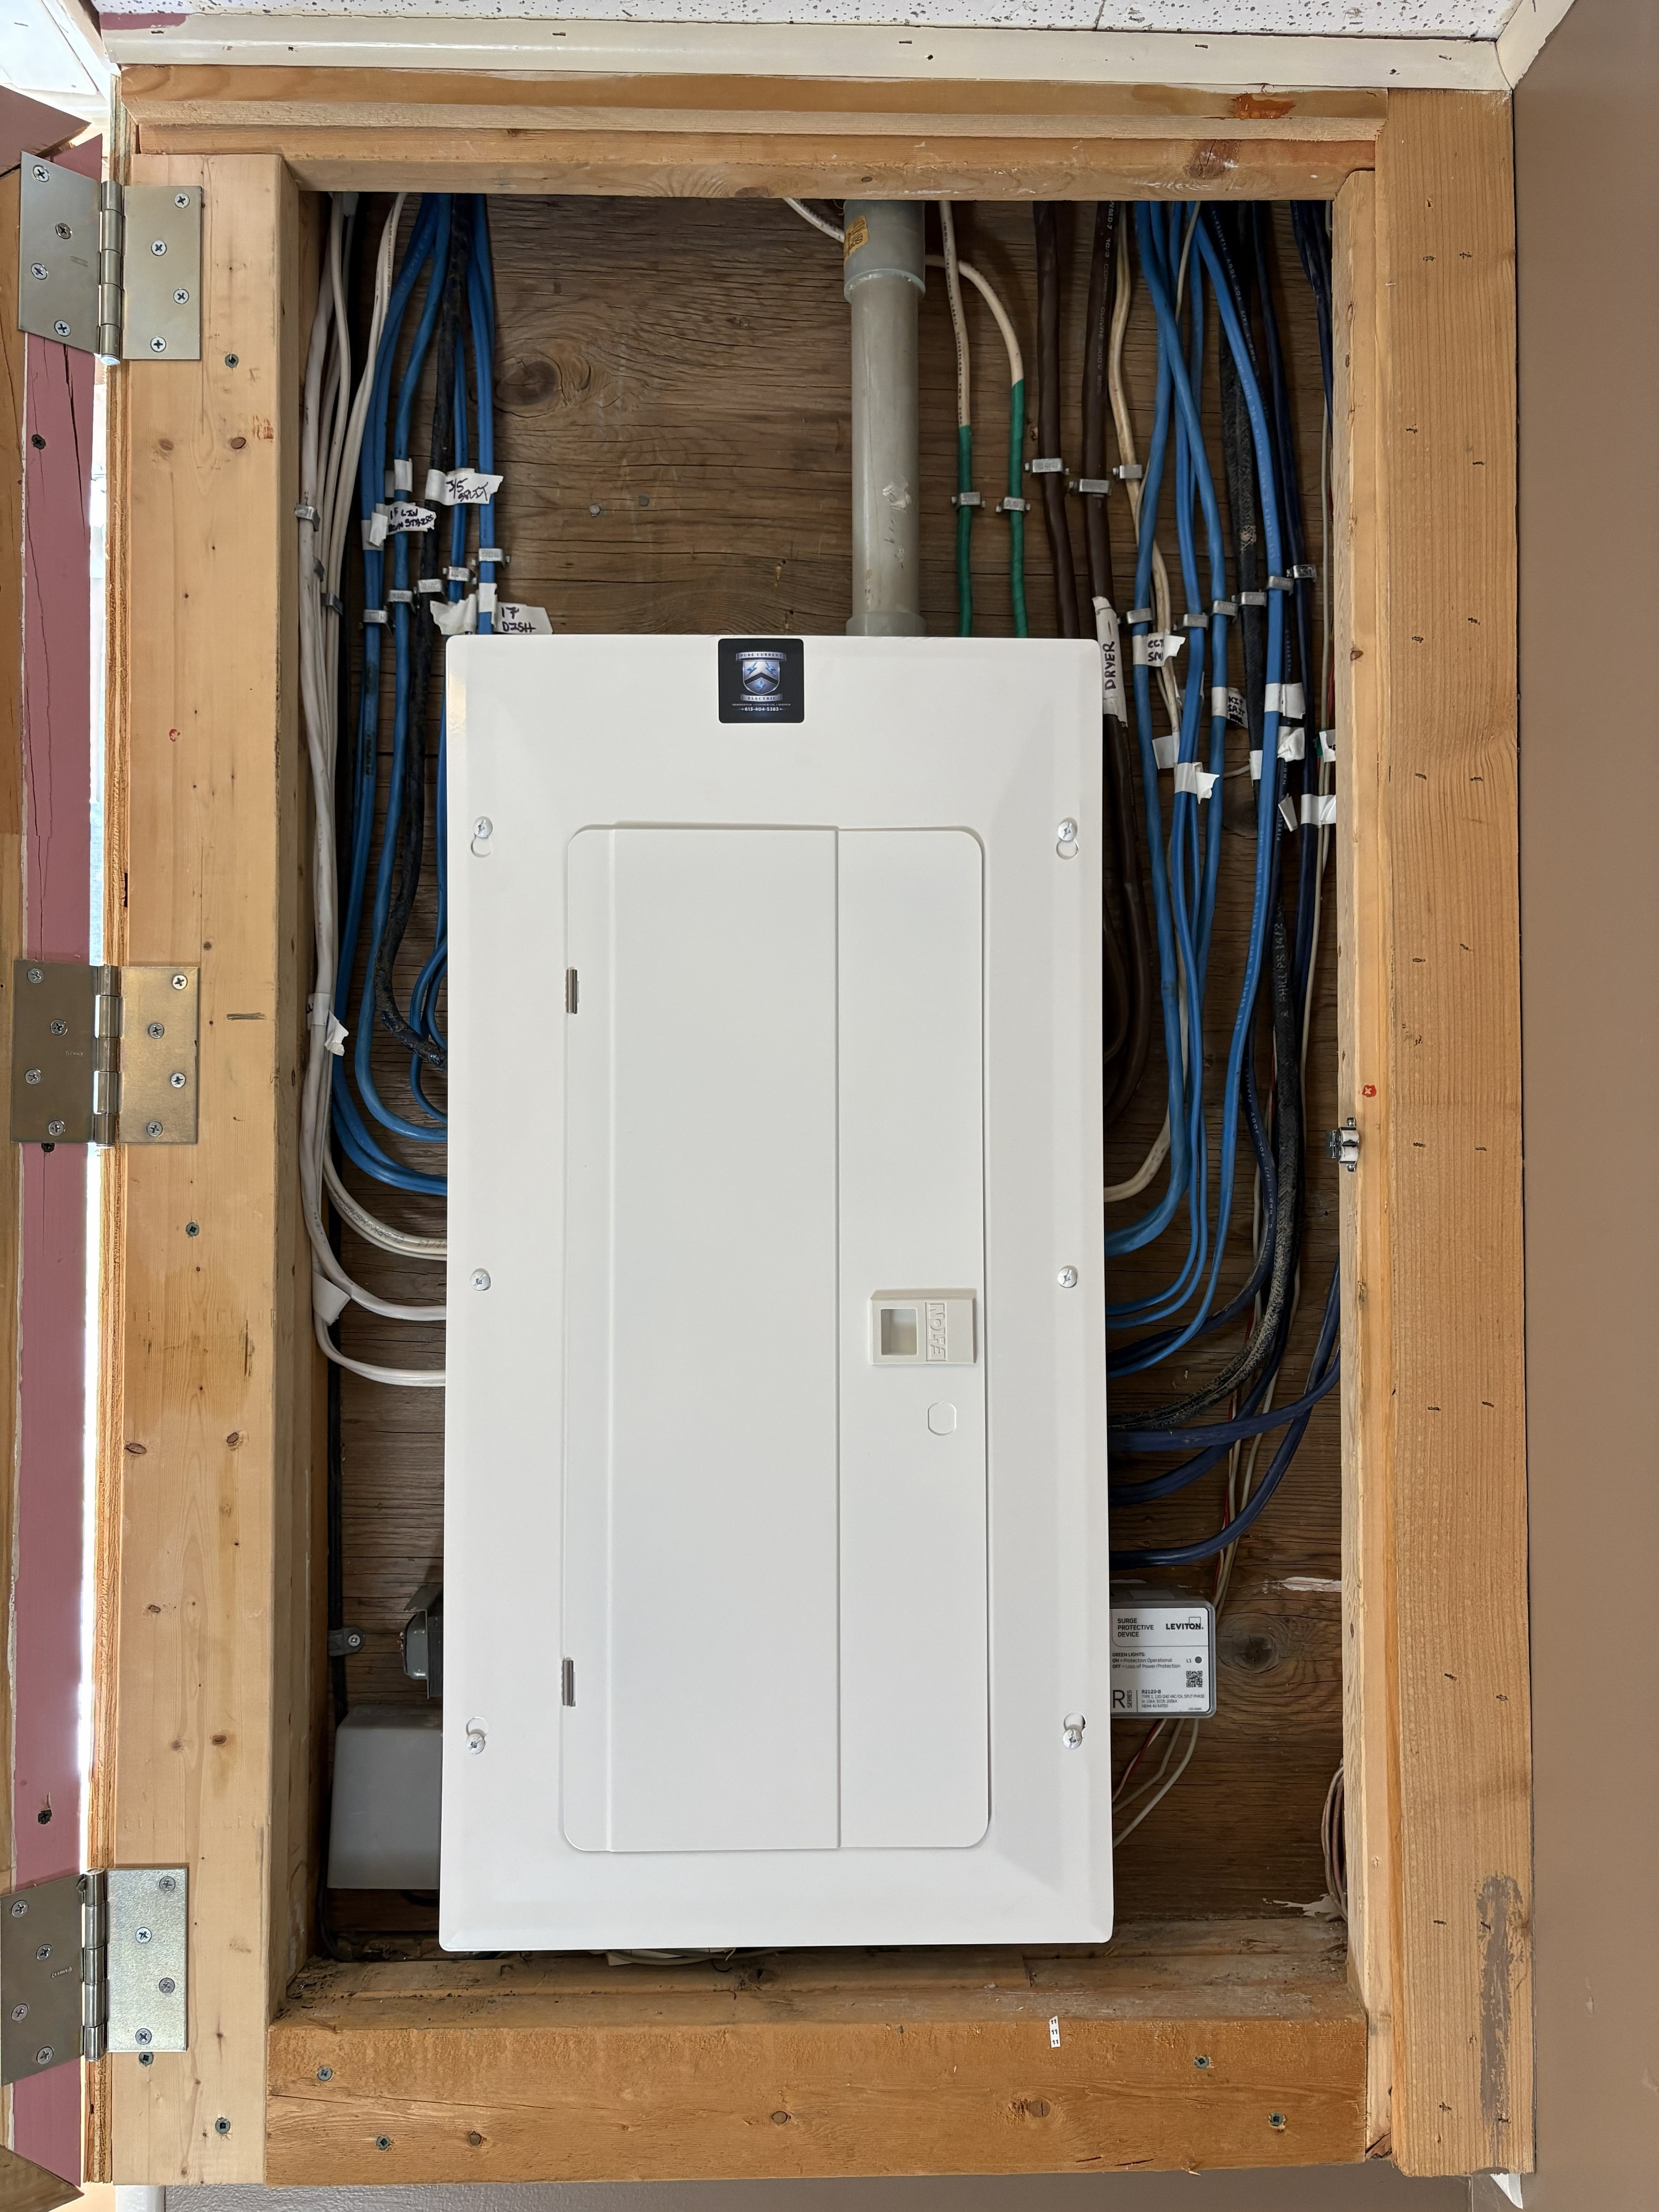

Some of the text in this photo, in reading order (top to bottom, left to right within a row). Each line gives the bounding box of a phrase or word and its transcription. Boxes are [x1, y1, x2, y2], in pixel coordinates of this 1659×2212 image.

[502, 621, 536, 632] DISH
[1103, 641, 1116, 690] DRYER
[1274, 923, 1285, 949] 14/2
[1251, 1112, 1259, 1134] 300V
[930, 1302, 945, 1359] EATON
[1112, 1690, 1125, 1709] R
